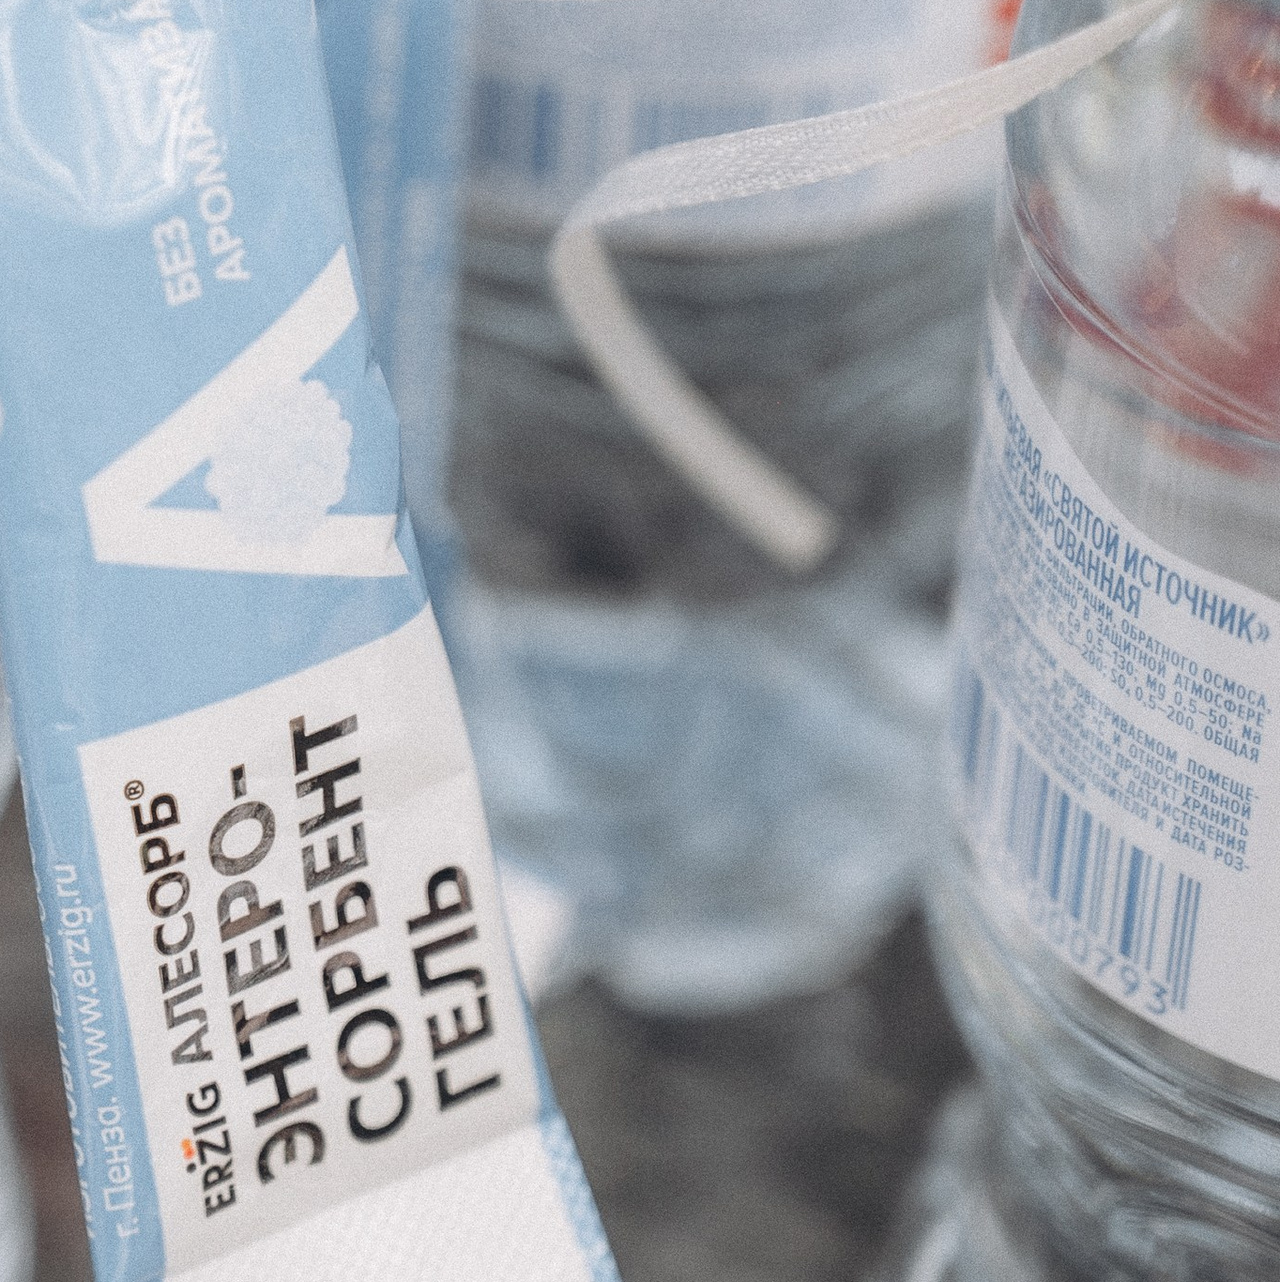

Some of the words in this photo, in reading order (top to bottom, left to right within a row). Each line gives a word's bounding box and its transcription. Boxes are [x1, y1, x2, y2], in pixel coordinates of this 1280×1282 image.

[152, 216, 202, 307] БЕЗ
[1042, 469, 1120, 566] «СВЯТОЙ
[1122, 540, 1271, 645] ИСТОЧНИК»
[1096, 617, 1167, 679] ЗАЩИТНОЙ
[1173, 672, 1266, 729] АТМОСФЕРЕ
[1121, 618, 1198, 677] ОБРАТНОГО
[1203, 668, 1271, 716] ОСМОСА,
[1145, 673, 1166, 701] Mg
[1241, 724, 1262, 746] Na
[1128, 743, 1253, 821] ОТНОСИТЕЛЬНОЙ
[1187, 757, 1260, 803] ПОМЕЩЕ-
[1203, 724, 1260, 764] ОБЩАЯ
[1162, 800, 1247, 855] ИСТЕЧЕНИЯ
[1171, 824, 1207, 855] ДАТА
[1214, 846, 1250, 872] РОЗ-
[1182, 792, 1249, 837] ХРАНИТЬ
[208, 762, 328, 1185] ЭНТЕРО-
[289, 712, 415, 1145] СОРБЕНТ
[51, 863, 114, 1090] www.erzig.ru
[406, 864, 502, 1113] ГЕЛЬ
